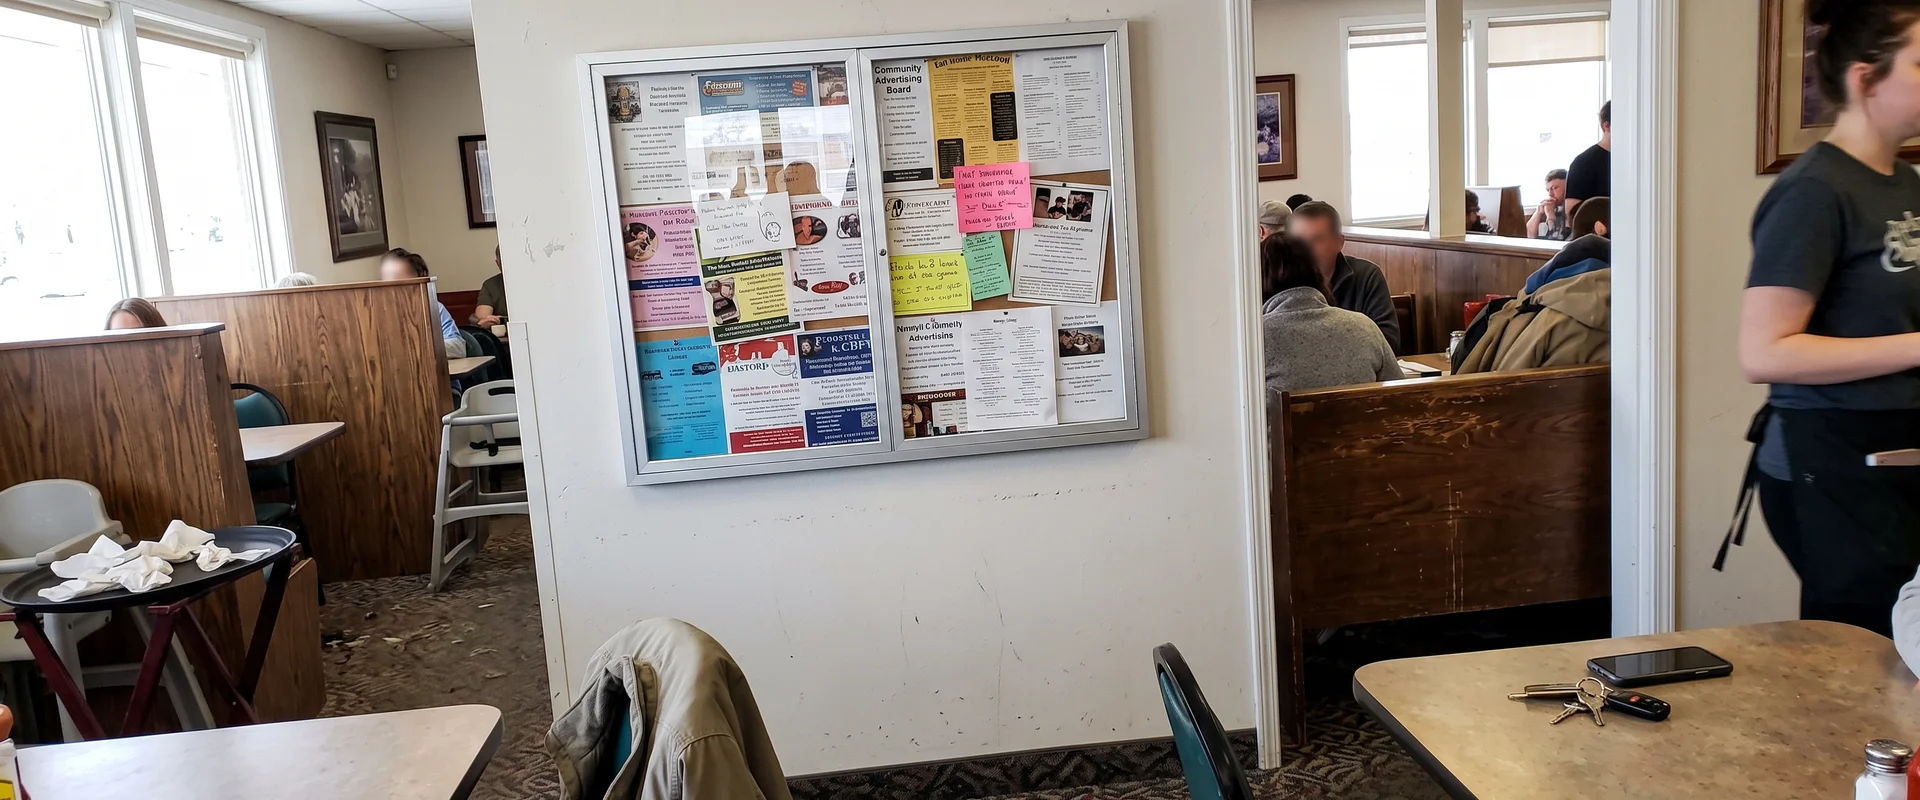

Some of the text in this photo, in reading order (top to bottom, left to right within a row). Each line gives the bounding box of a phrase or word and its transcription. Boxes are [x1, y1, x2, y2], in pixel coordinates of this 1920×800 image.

[874, 64, 922, 75] Community
[875, 75, 922, 85] Advertising
[886, 85, 912, 94] Board
